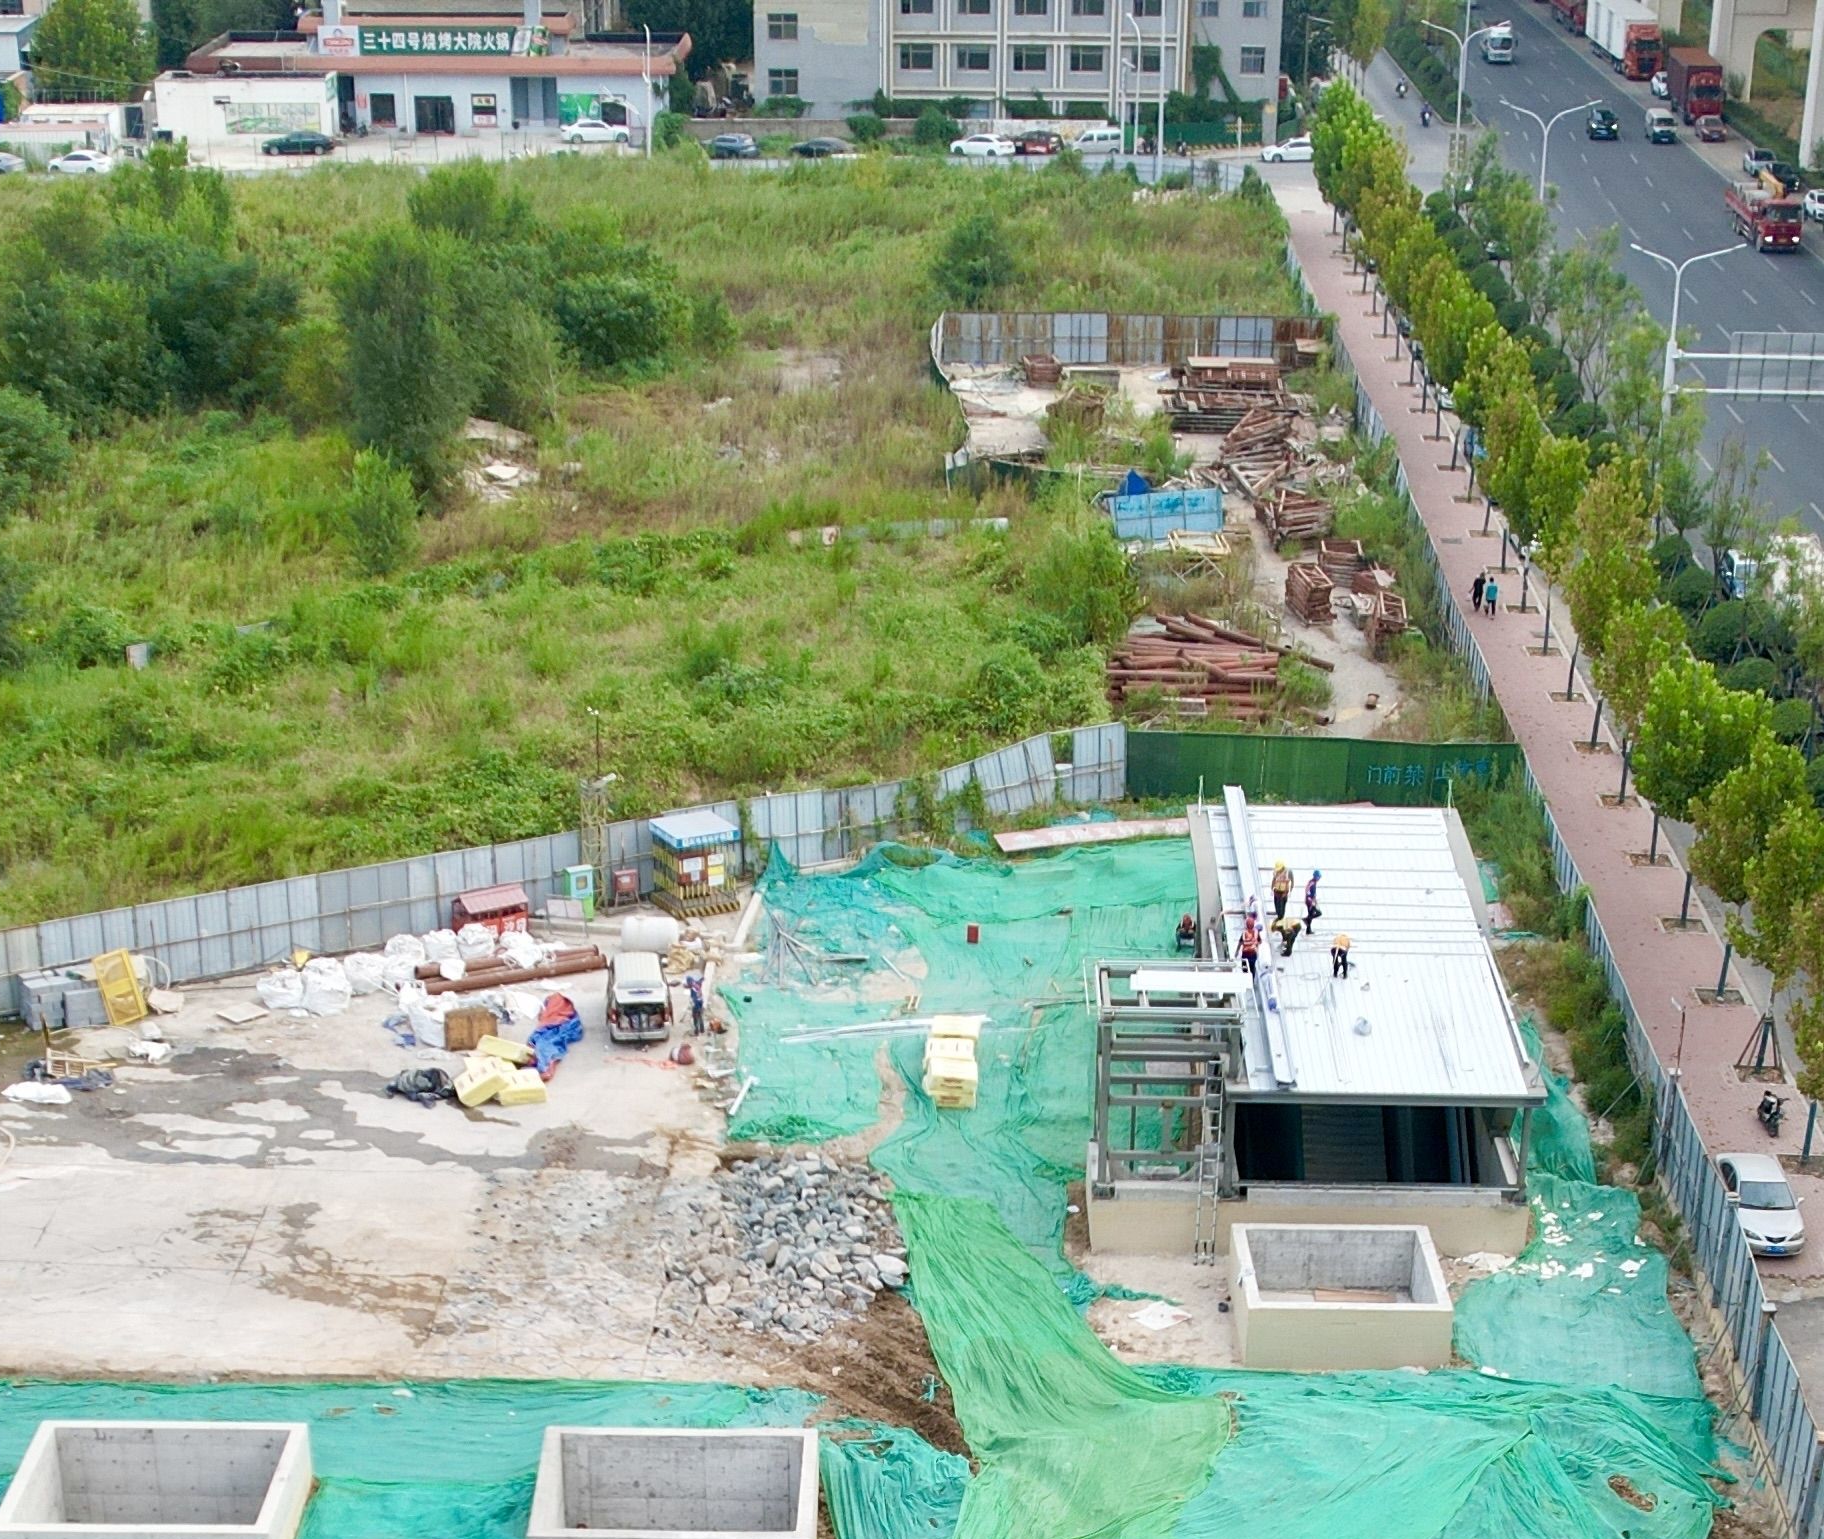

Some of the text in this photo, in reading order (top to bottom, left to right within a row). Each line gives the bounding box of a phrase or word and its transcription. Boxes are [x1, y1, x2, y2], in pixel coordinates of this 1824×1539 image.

[363, 31, 510, 51] 三十四号烧烤大院火锅
